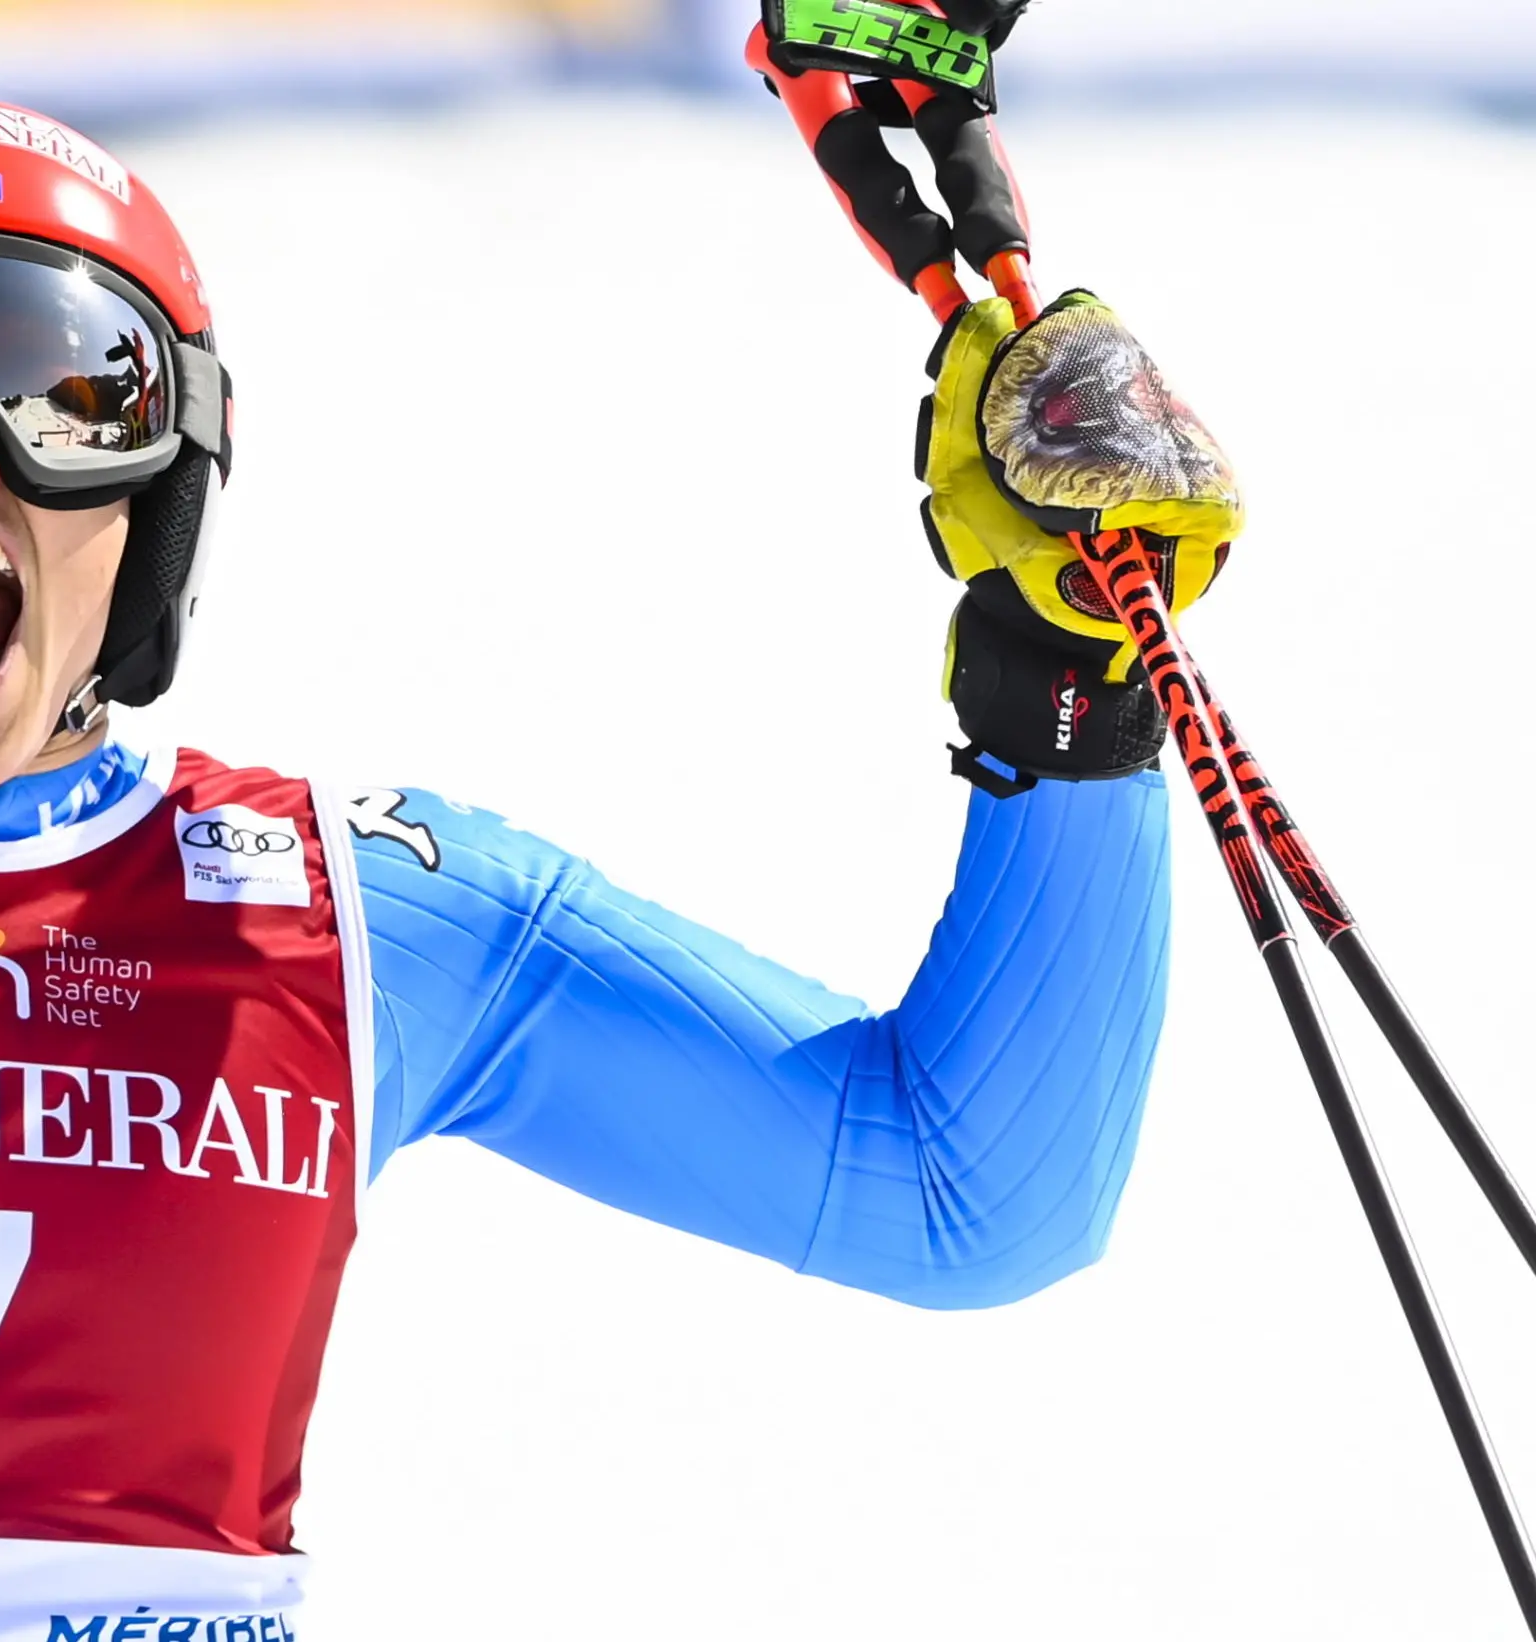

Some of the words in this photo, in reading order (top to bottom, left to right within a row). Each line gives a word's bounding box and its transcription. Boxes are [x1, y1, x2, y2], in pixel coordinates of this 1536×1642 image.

[193, 862, 221, 873] Audi
[193, 871, 213, 882] FIS
[215, 875, 233, 885] Ski
[41, 924, 98, 951] The
[45, 950, 153, 981] Human
[44, 976, 142, 1012] Safety
[46, 1003, 102, 1028] Net
